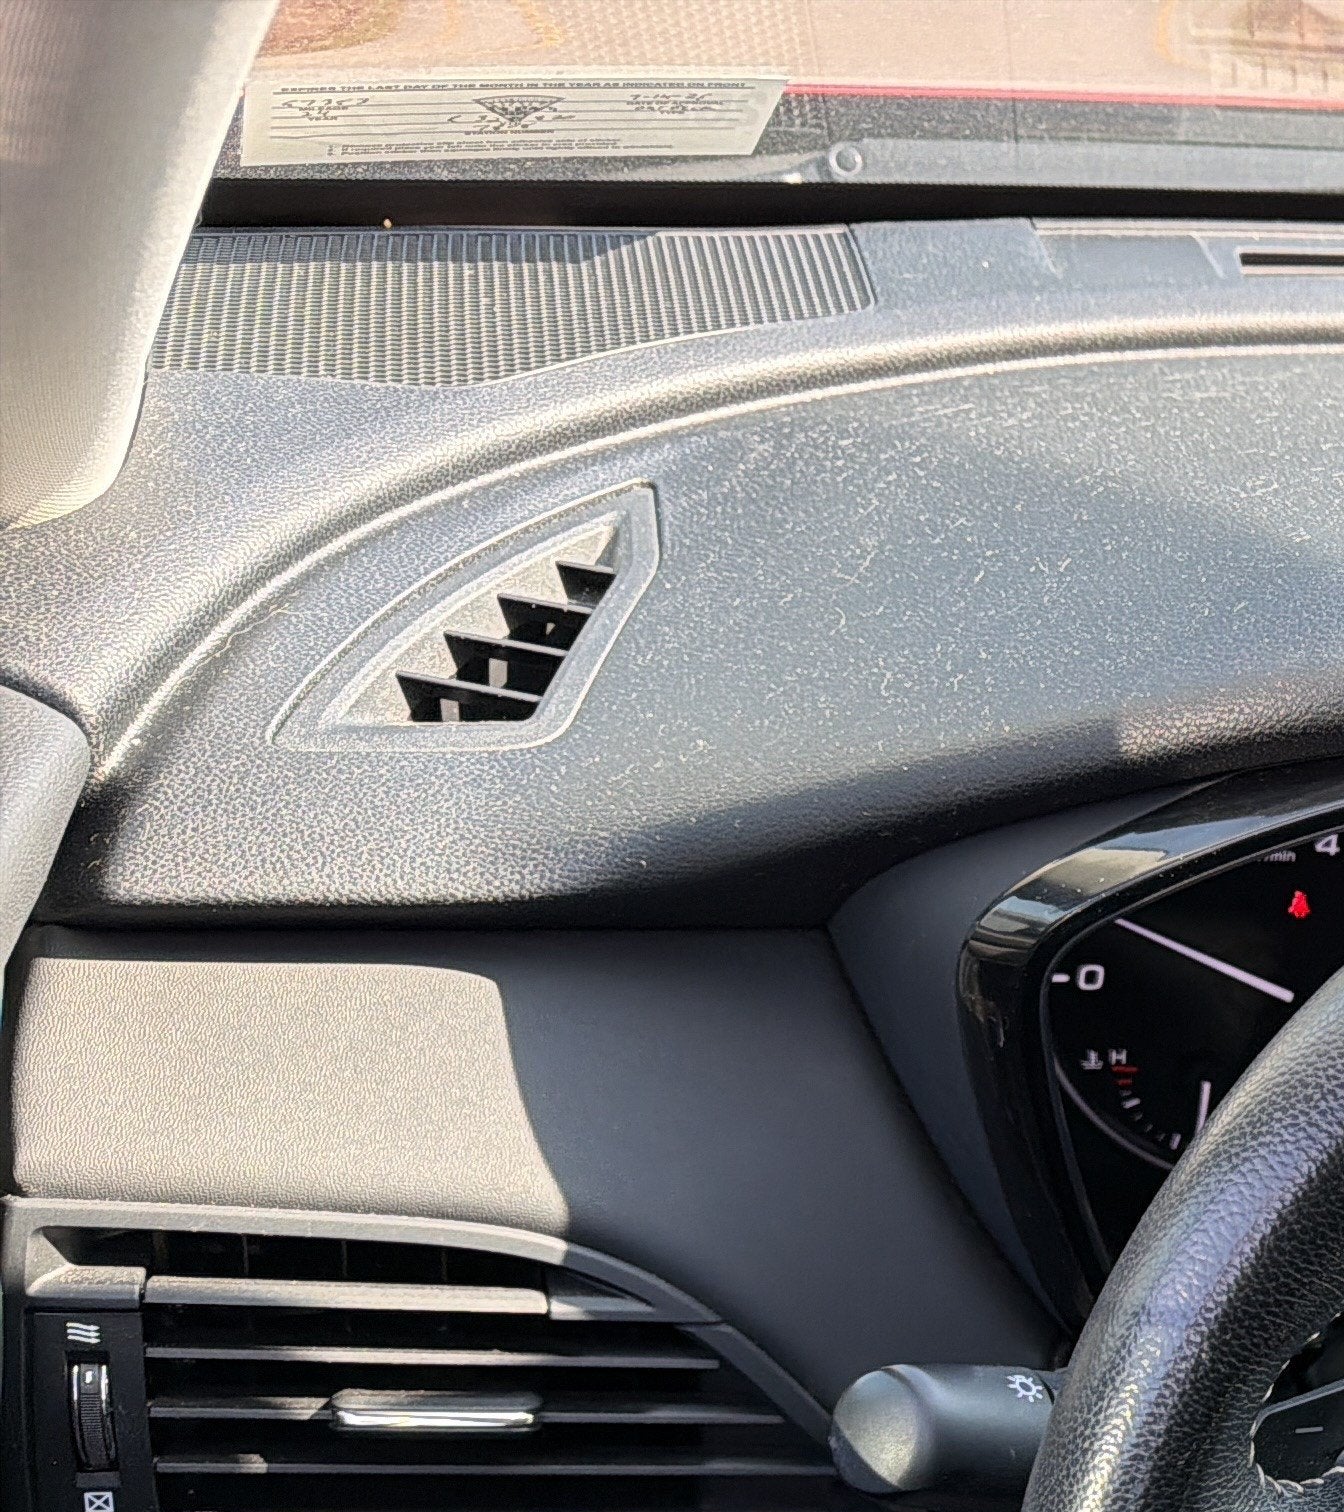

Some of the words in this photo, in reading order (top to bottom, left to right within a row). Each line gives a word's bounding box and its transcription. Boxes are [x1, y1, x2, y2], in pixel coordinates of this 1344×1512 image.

[1314, 833, 1340, 856] 4
[1076, 964, 1105, 991] 0
[1108, 1049, 1127, 1065] H
